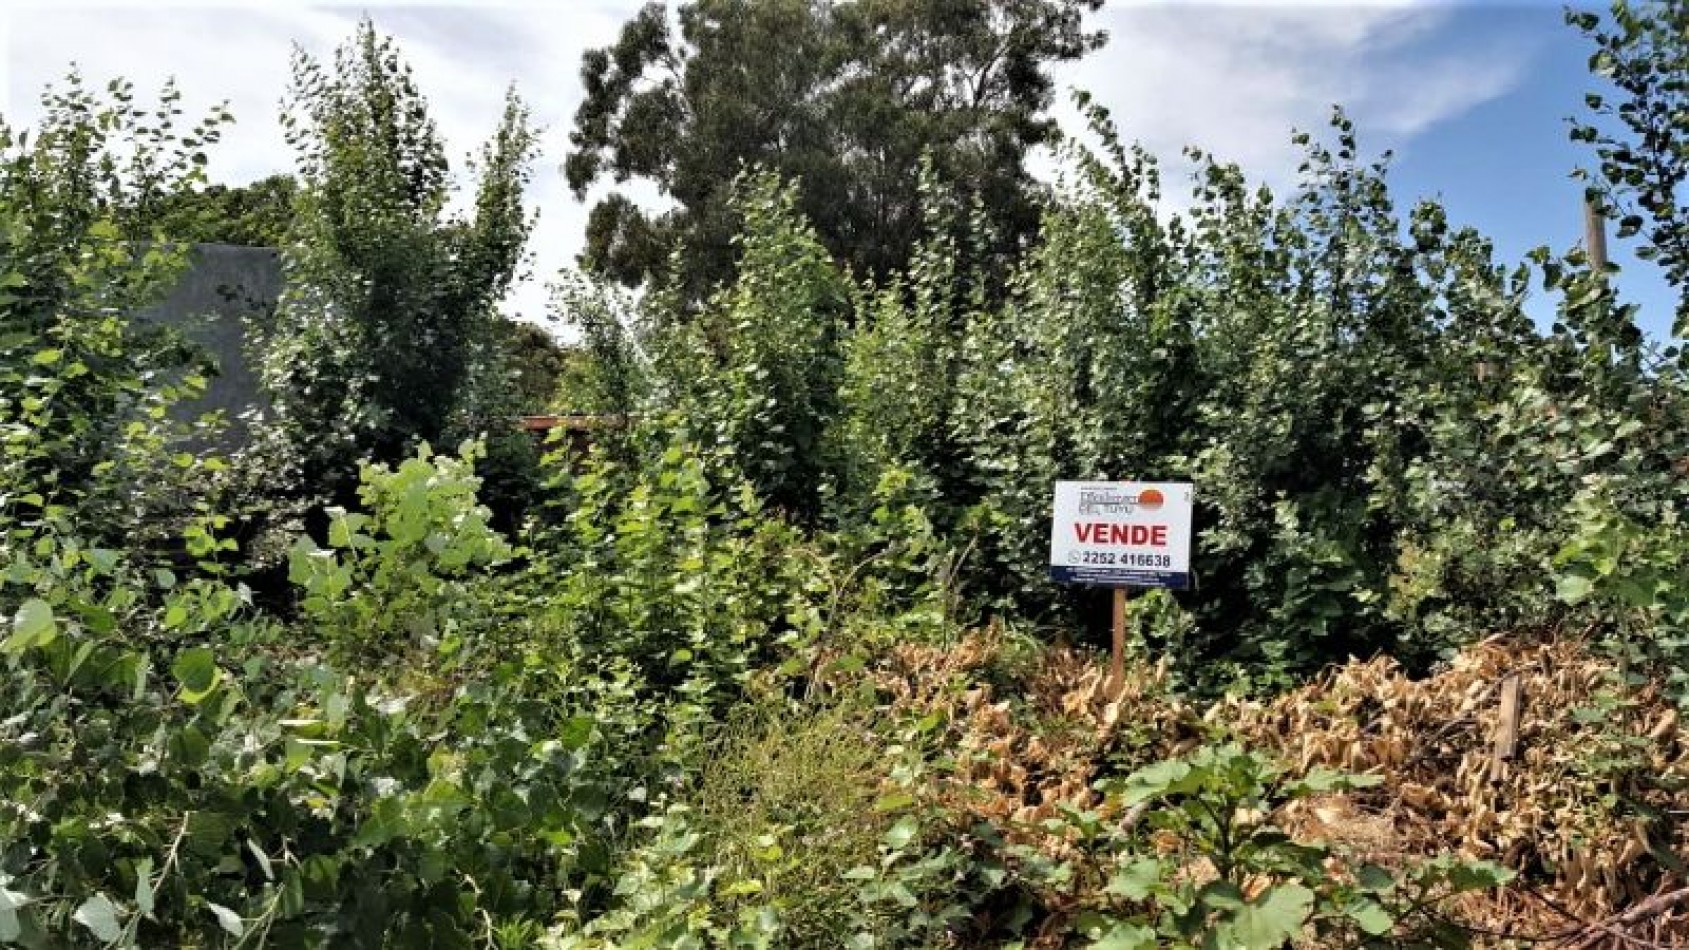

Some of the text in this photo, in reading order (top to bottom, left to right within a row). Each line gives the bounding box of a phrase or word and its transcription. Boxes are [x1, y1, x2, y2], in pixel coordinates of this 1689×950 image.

[1074, 523, 1167, 547] VENDE
[1083, 551, 1171, 567] 2252 416638
